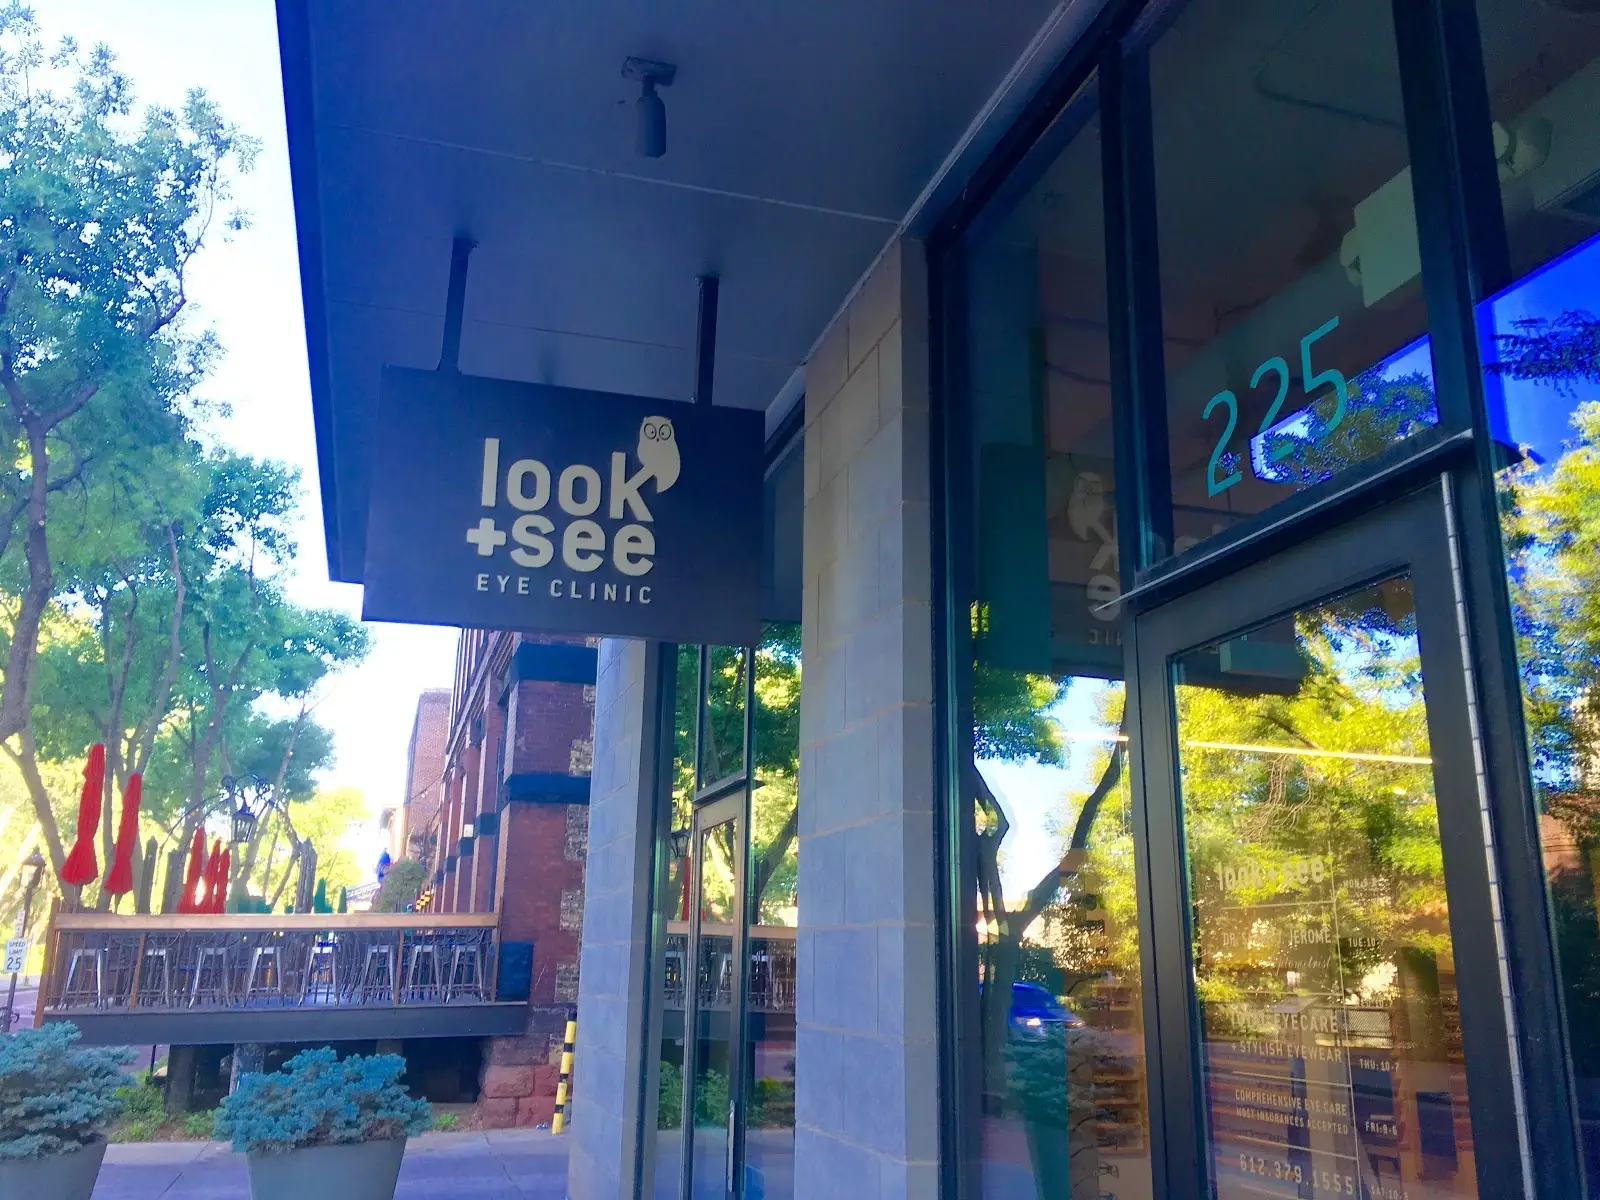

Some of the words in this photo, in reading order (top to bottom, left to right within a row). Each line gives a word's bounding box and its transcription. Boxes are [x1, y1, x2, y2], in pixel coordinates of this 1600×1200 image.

[1202, 316, 1339, 498] 225
[481, 437, 656, 523] look
[477, 573, 531, 595] EYE
[550, 579, 652, 604] CLINIC
[8, 941, 26, 949] SPEED
[1288, 928, 1332, 946] JEROME
[6, 956, 22, 971] 25
[1274, 1011, 1339, 1033] EYECARE
[1240, 1041, 1283, 1057] STYLISH
[1287, 1045, 1342, 1063] EYEWEAR
[1235, 1088, 1302, 1110] COMPREHENSIVE
[1304, 1099, 1321, 1113] EYE
[1323, 1101, 1347, 1117] CARE
[1257, 1110, 1305, 1128] INSURANCES
[1306, 1118, 1349, 1136] ACCEPTED
[1239, 1153, 1354, 1196] 612.379.1555
